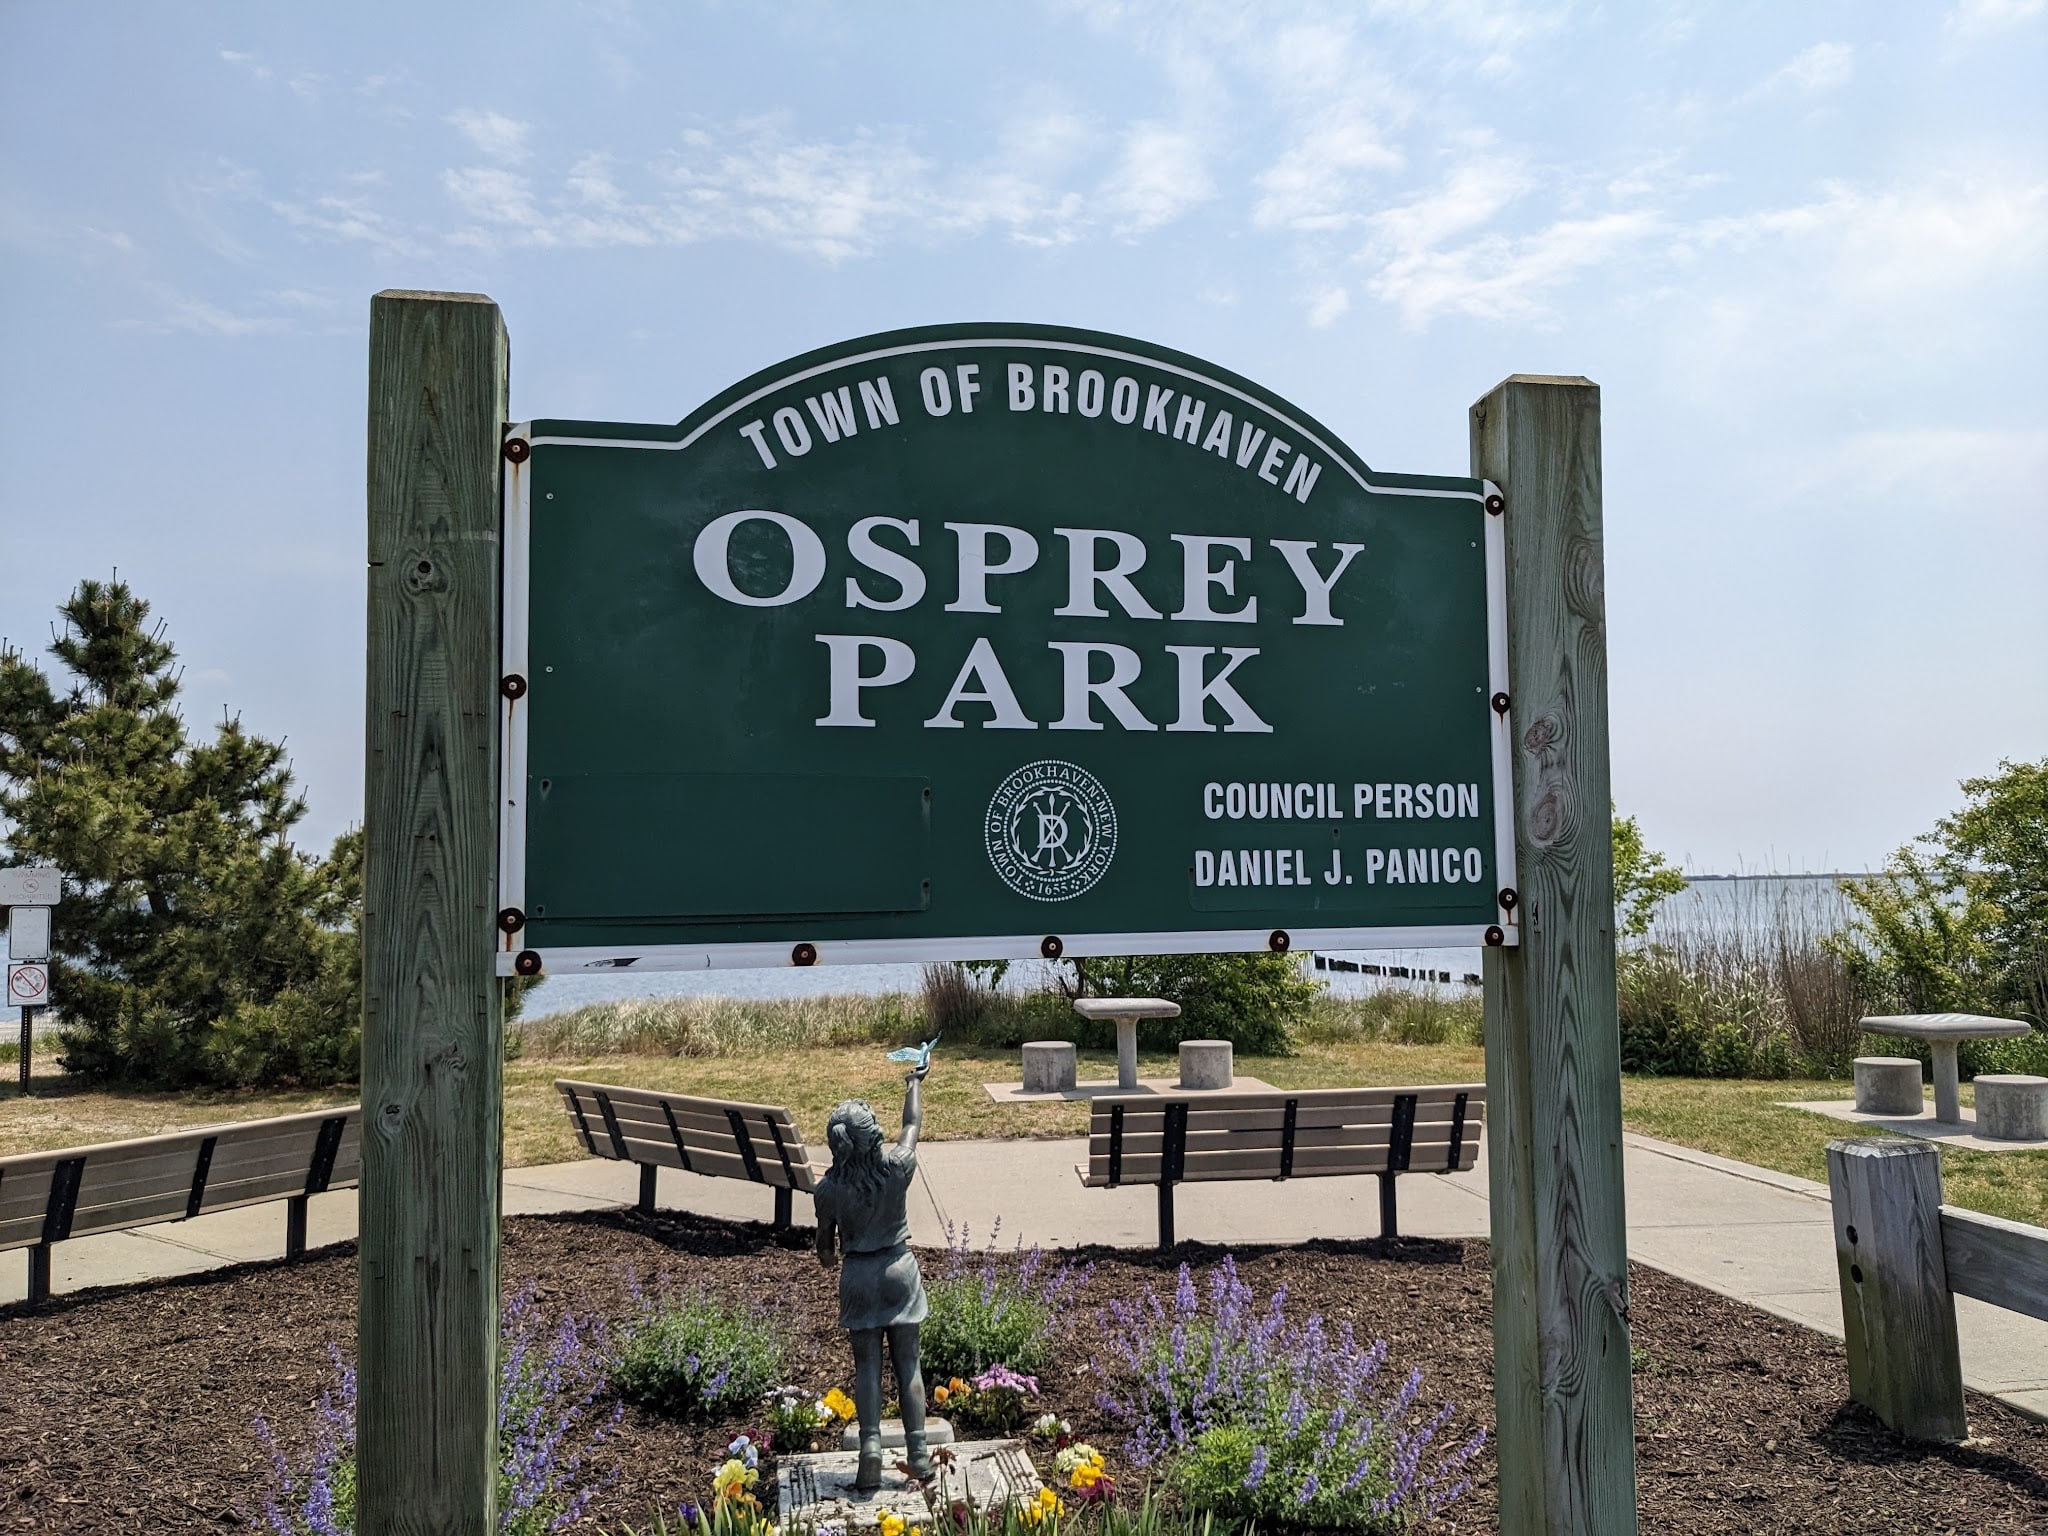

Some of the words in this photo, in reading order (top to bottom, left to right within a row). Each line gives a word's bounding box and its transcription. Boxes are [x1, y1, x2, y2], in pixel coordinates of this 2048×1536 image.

[740, 376, 900, 470] TOWN
[920, 364, 980, 417] OF
[1008, 362, 1323, 504] BROOKHAVEN
[693, 510, 1366, 626] OSPREY
[815, 634, 1274, 734] PARK
[996, 765, 1100, 808] BROOKHAVEN
[1204, 782, 1344, 819] COUNCIL
[1354, 783, 1479, 819] PERSON
[990, 810, 1003, 833] OF
[1097, 800, 1113, 838] NEW
[991, 839, 1024, 886] TOWN
[1078, 846, 1112, 885] YORK
[1195, 850, 1312, 887] DANIEL
[1324, 849, 1354, 885] J.
[1366, 847, 1483, 884] PANICO
[1037, 882, 1069, 896] 1655
